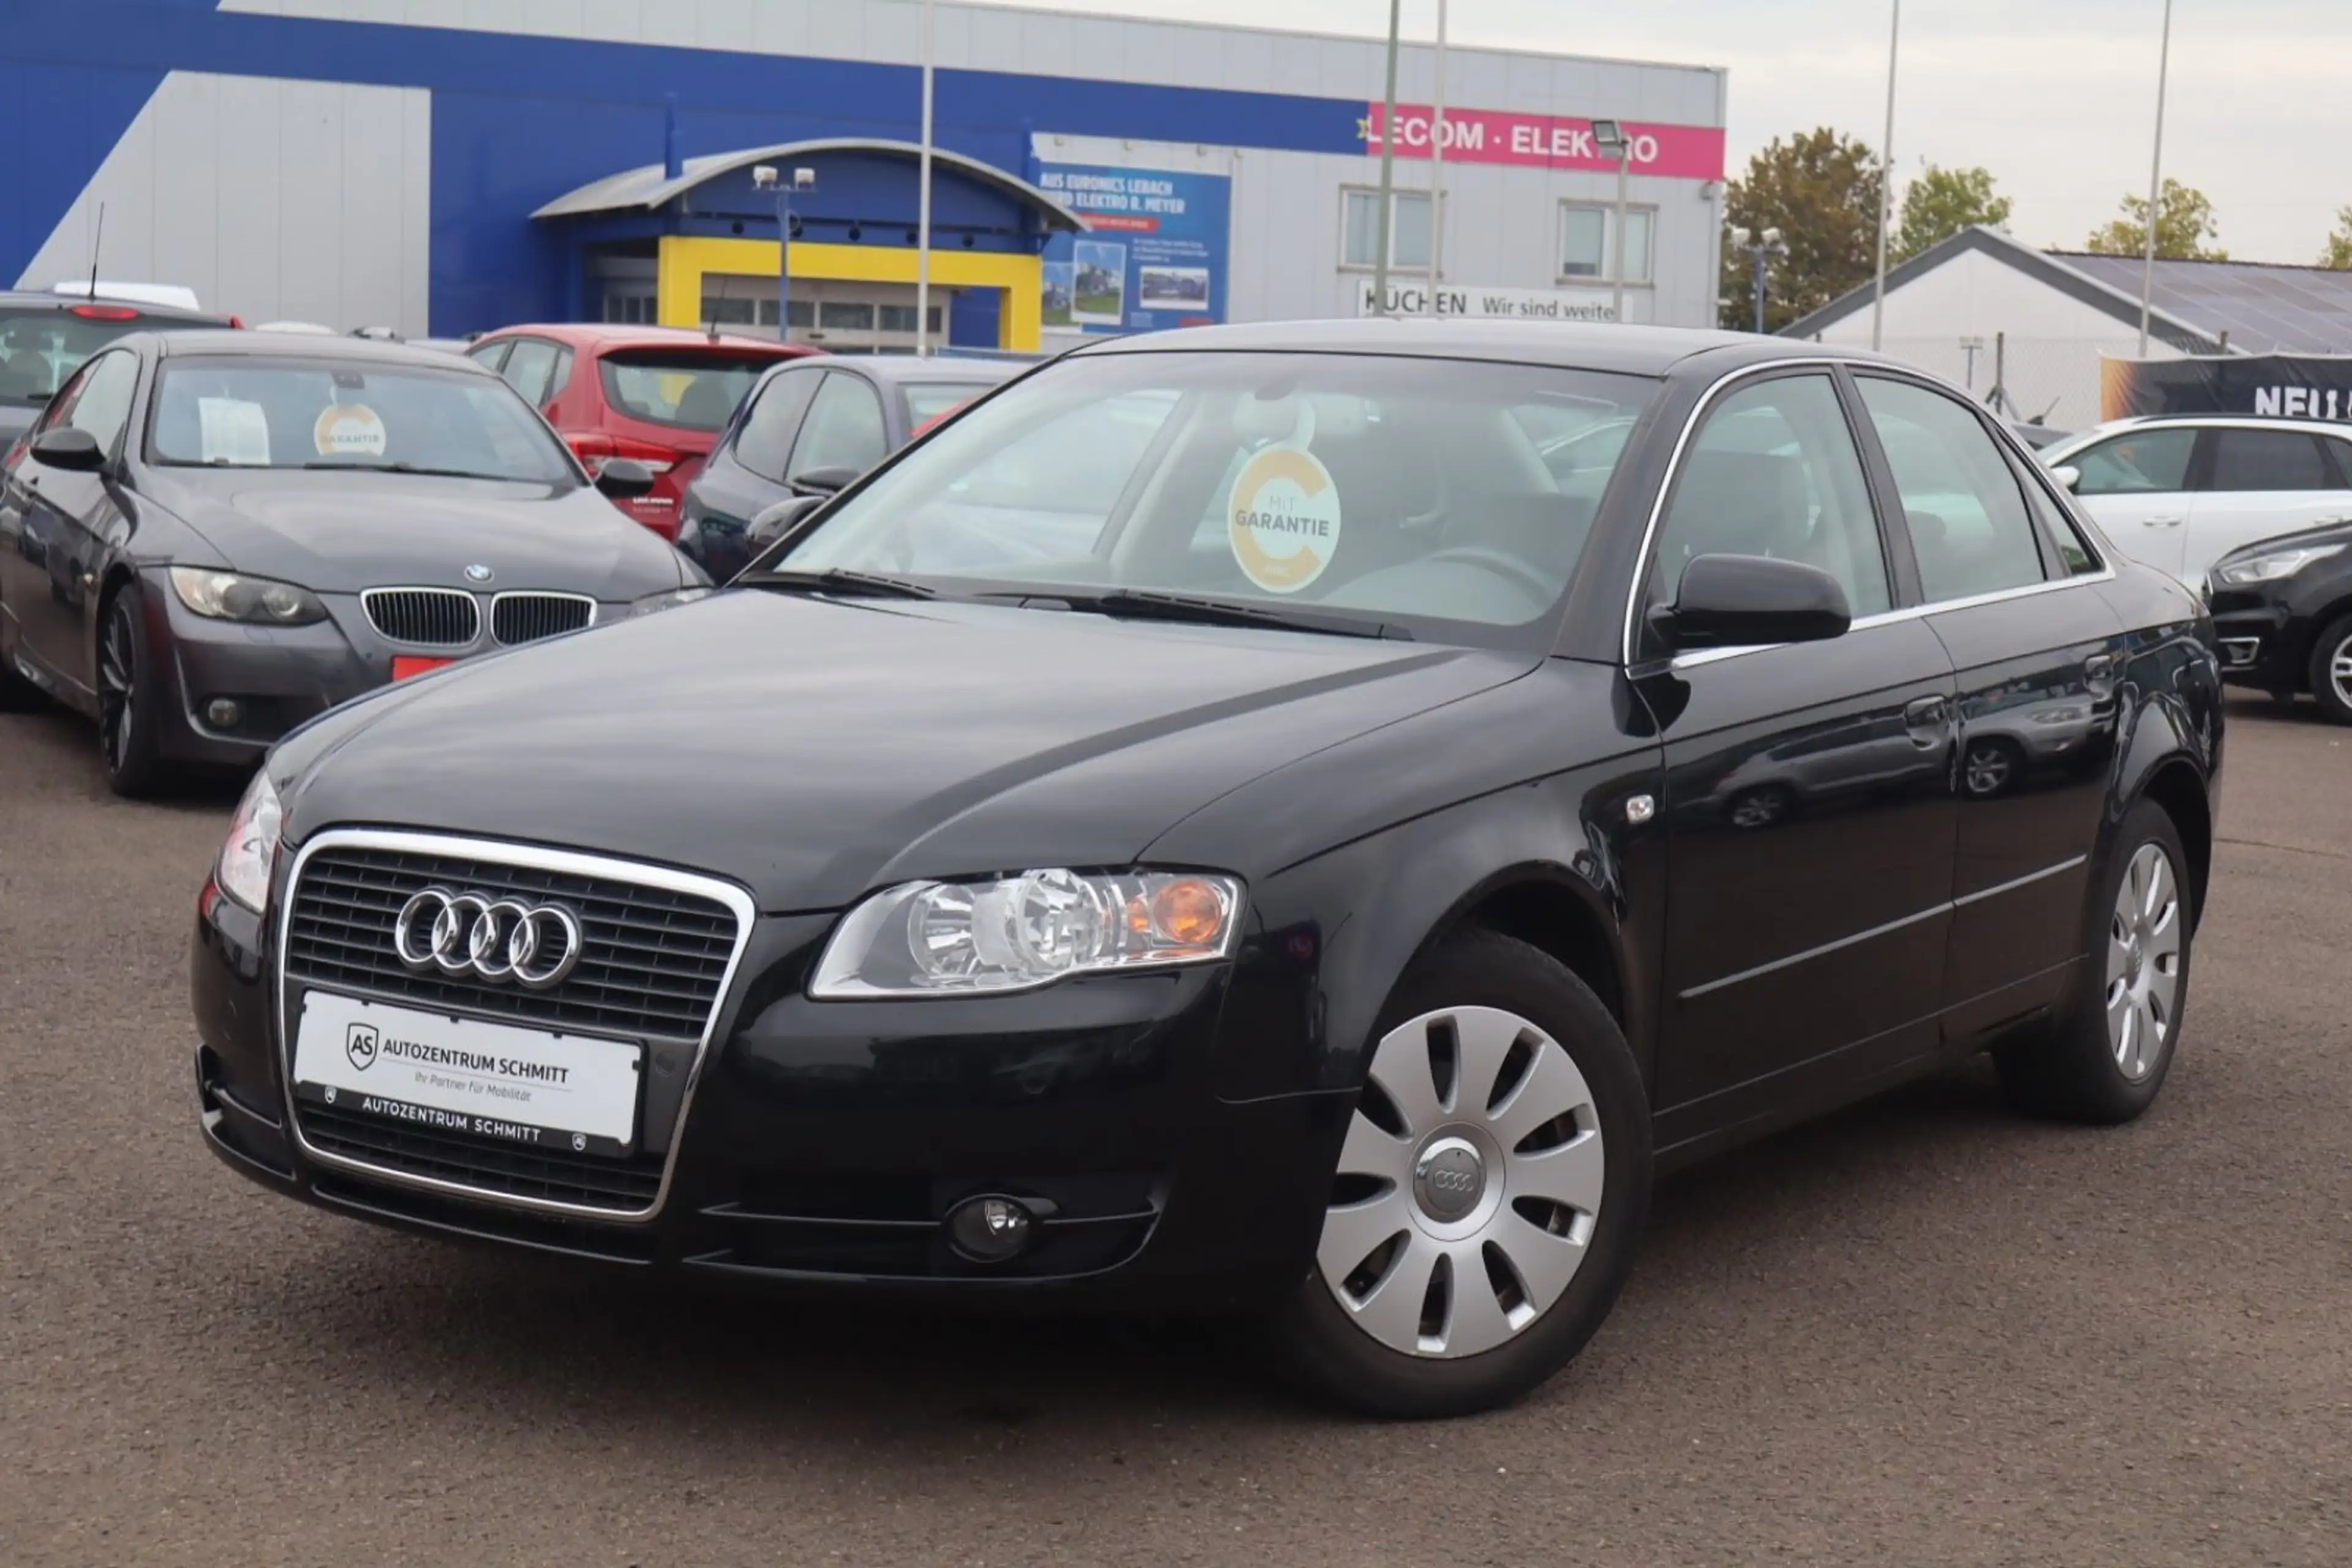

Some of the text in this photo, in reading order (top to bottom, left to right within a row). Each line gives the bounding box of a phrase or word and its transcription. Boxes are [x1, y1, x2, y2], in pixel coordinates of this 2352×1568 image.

[1511, 125, 1658, 163] ELEKRO
[1483, 296, 1514, 315] Wir
[1520, 300, 1558, 318] sind
[1564, 302, 1616, 320] weite
[1270, 495, 1298, 512] MIT
[1235, 509, 1329, 537] GARANTIE
[352, 1034, 570, 1084] AS AUTOZENTRUM SCHMITT
[415, 1071, 532, 1102] Ihr Partner für Mobilität
[362, 1097, 467, 1130] AUTOZENTRUM
[474, 1118, 541, 1142] SCHMITT
